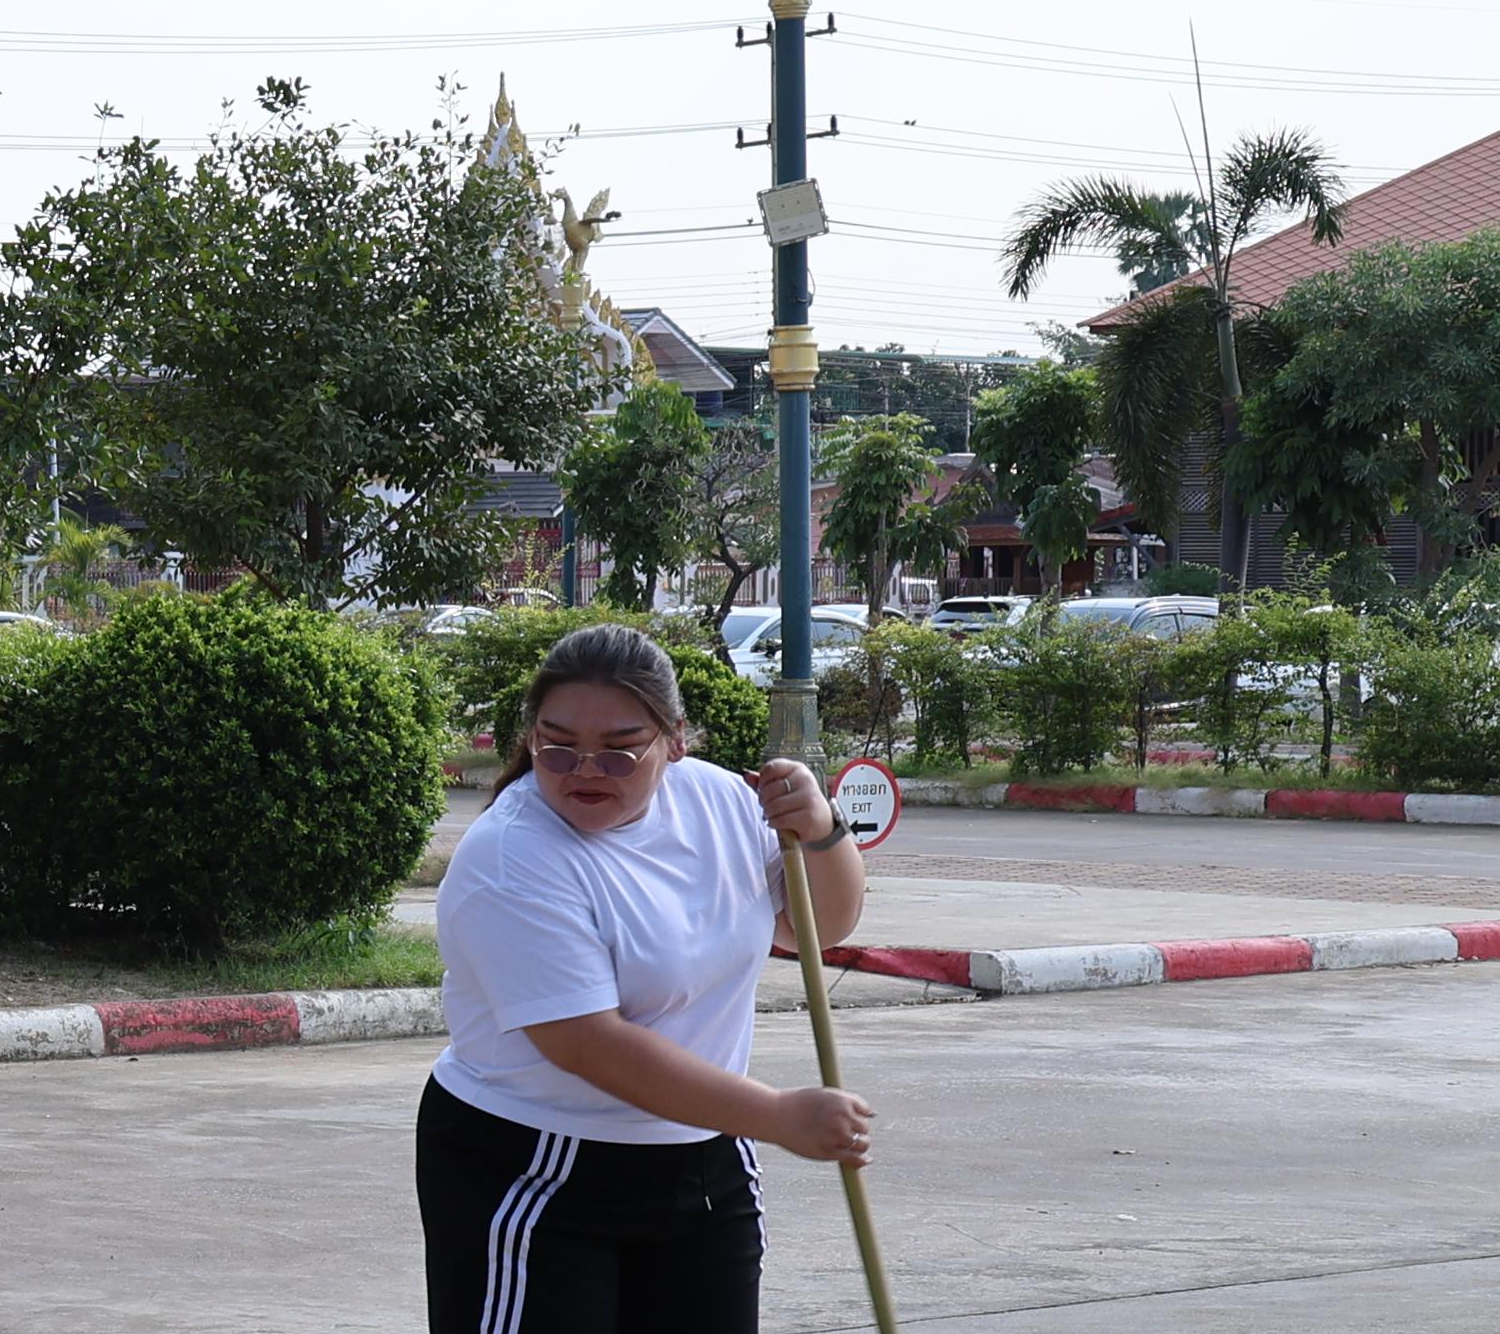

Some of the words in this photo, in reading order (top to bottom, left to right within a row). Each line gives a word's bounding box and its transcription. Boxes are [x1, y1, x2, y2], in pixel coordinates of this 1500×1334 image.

[842, 783, 887, 796] ทางออก
[851, 802, 873, 814] EXIT
